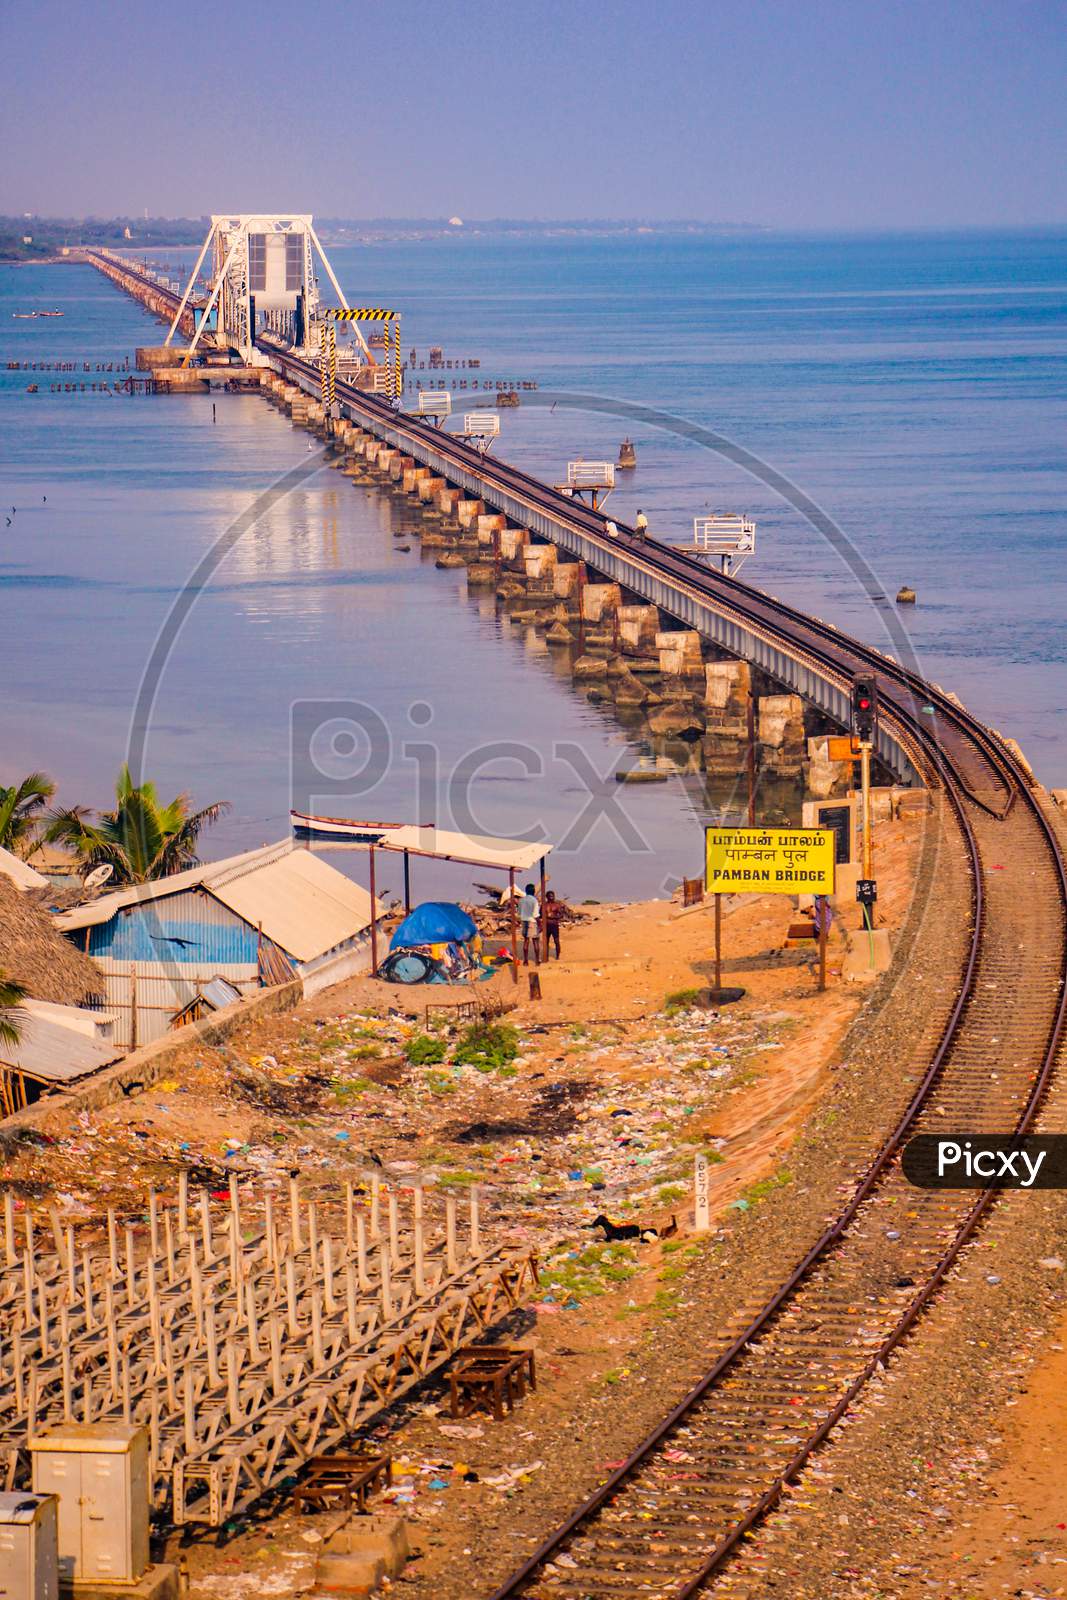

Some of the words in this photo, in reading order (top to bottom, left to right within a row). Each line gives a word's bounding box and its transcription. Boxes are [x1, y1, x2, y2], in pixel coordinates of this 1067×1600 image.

[713, 830, 773, 846] பாம்பன்
[778, 831, 826, 845] பாலம்
[726, 850, 777, 861] पाम्बन
[783, 850, 809, 869] पुल
[713, 869, 770, 881] PAMBAN
[775, 870, 826, 881] BRIDGE
